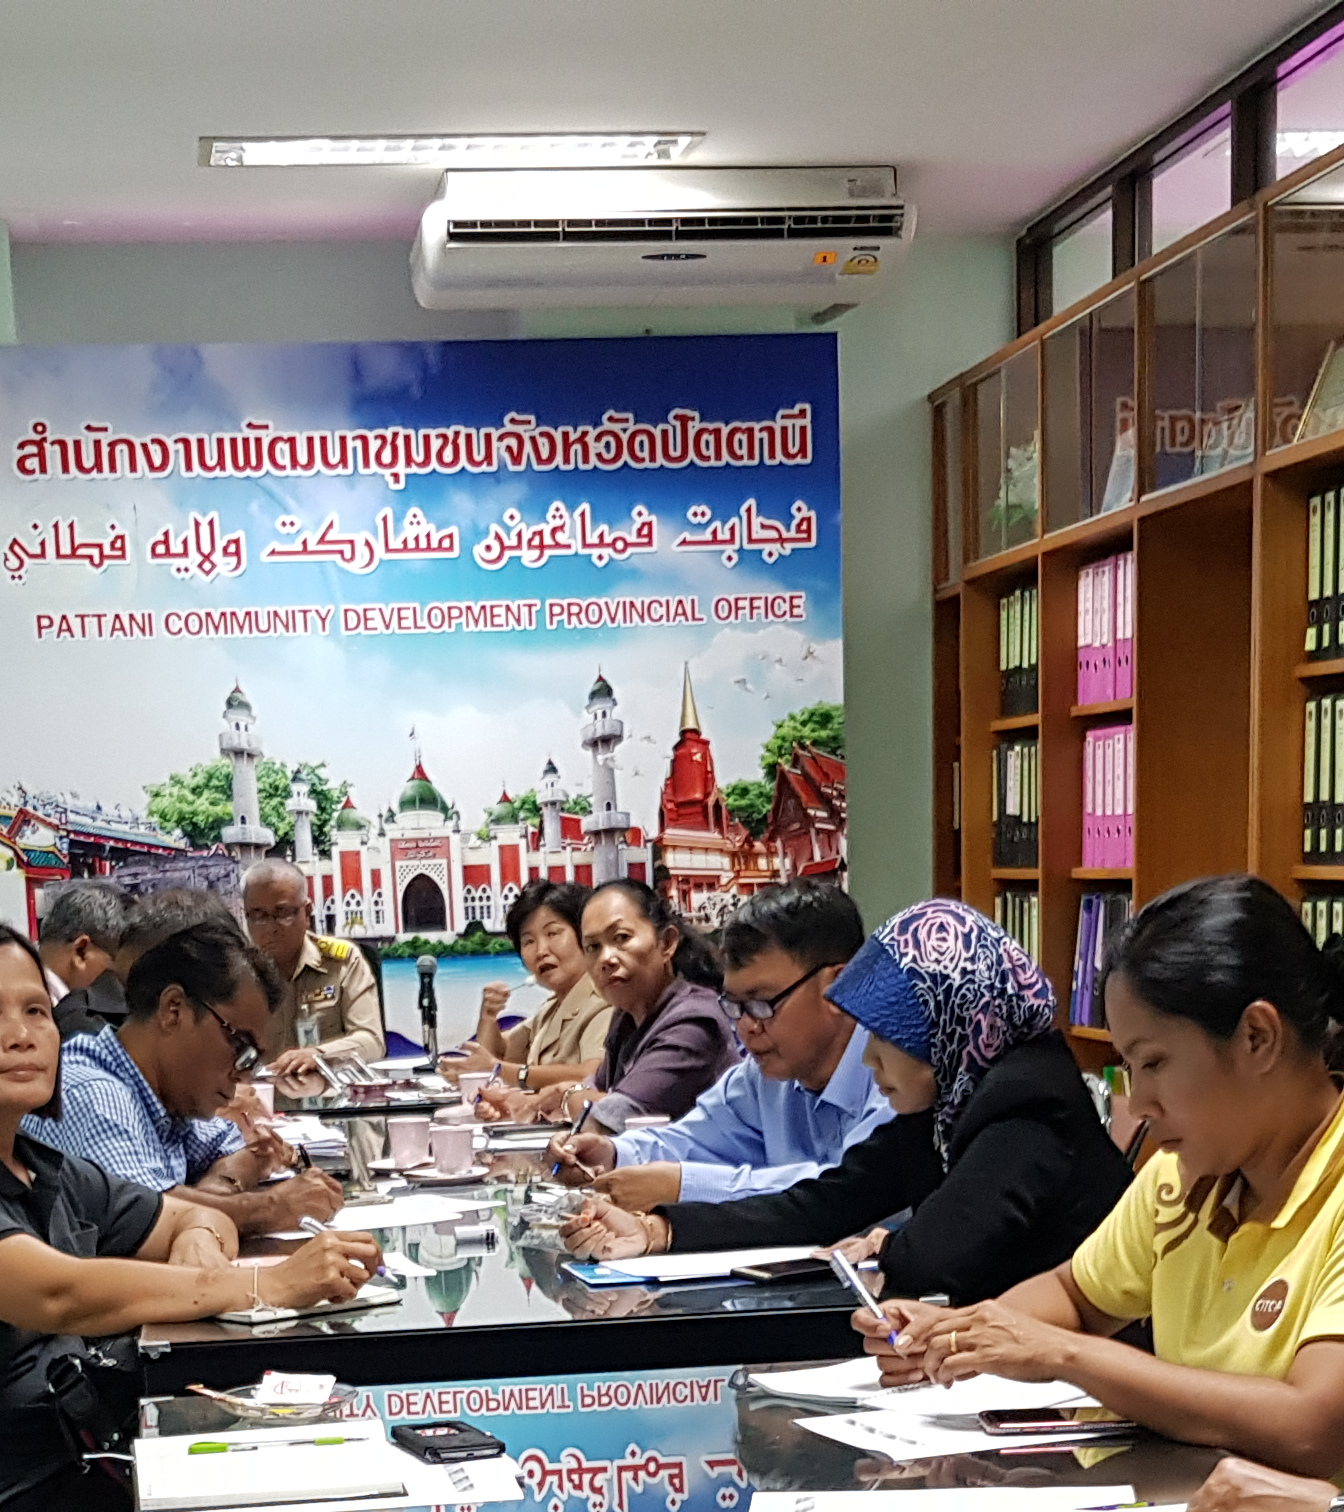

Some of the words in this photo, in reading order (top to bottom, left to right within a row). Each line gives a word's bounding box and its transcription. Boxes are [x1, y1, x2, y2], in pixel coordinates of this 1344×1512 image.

[15, 405, 809, 485] สำนักงานพัฒนาชุมชนจังหวัดปัตตานี
[36, 612, 154, 640] PATTANI
[164, 608, 332, 636] COMMUNITY
[343, 602, 538, 632] DEVELOPMENT
[548, 598, 703, 627] PROVINCIAL
[714, 594, 805, 622] OFFICE
